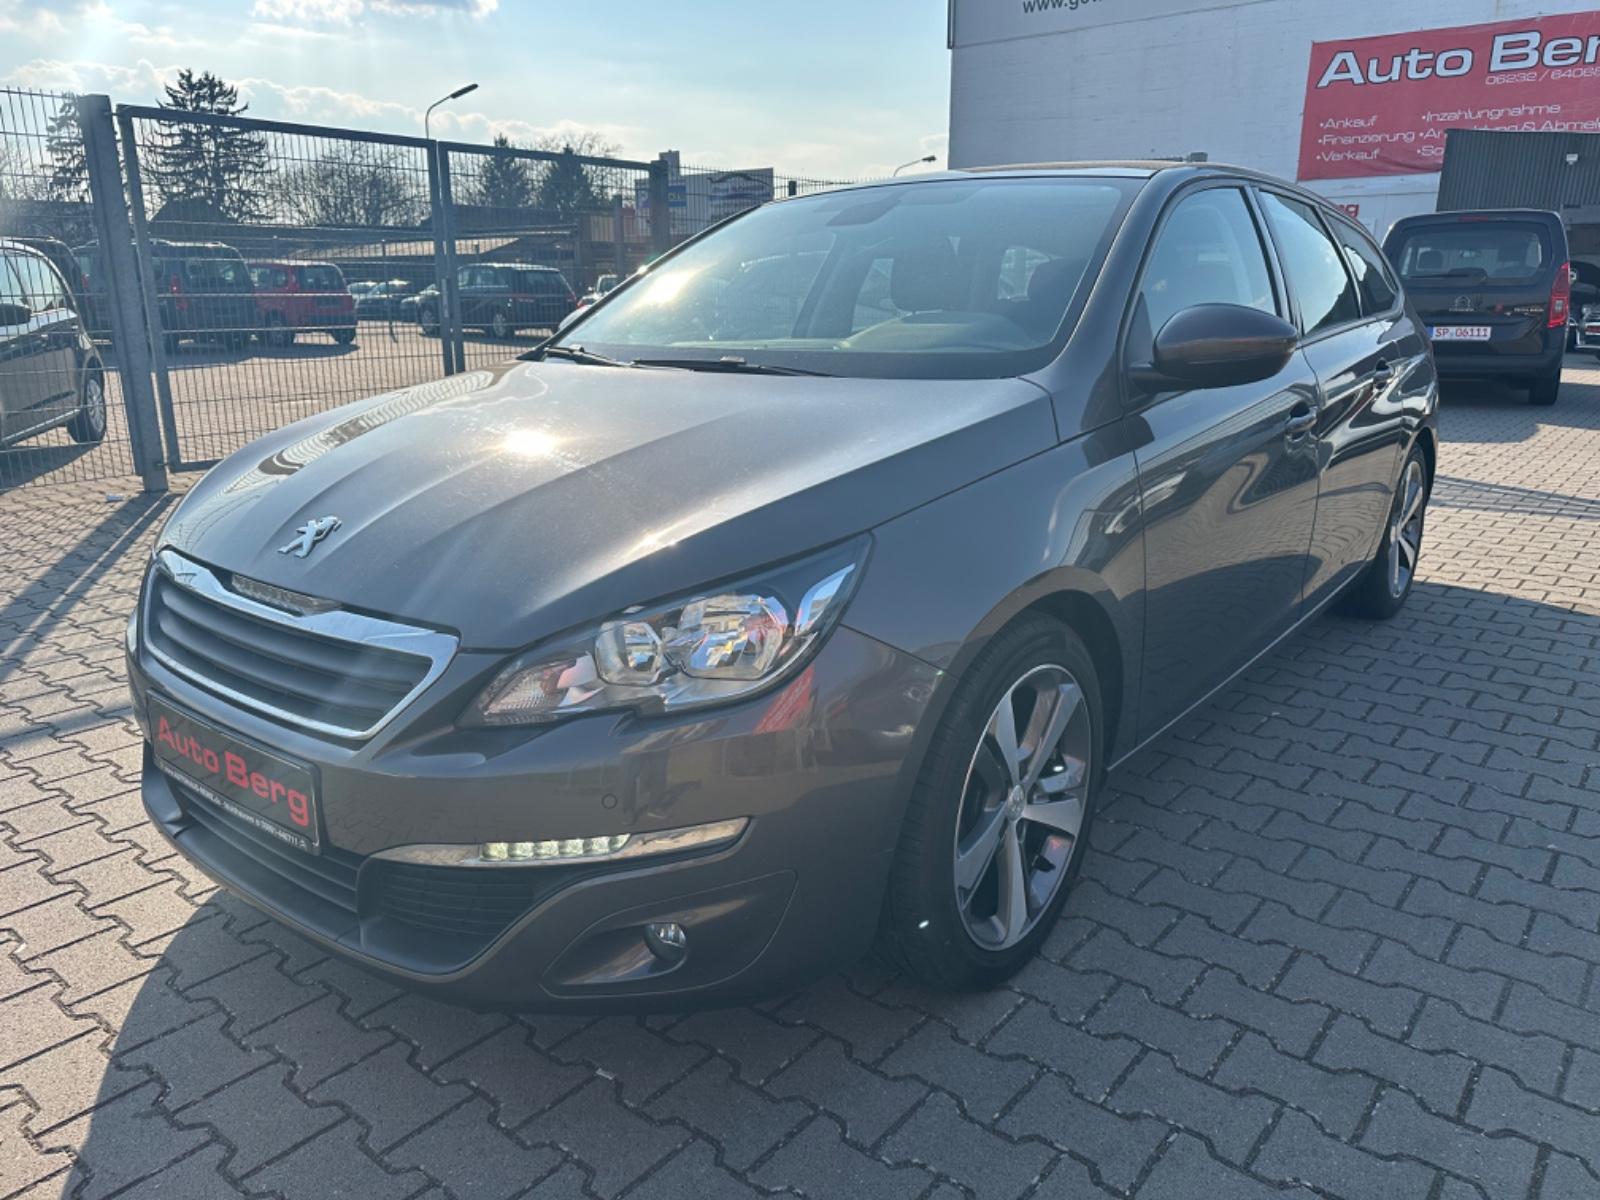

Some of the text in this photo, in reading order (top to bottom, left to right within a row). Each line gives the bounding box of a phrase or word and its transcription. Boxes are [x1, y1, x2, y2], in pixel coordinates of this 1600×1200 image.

[1316, 47, 1473, 89] Auto
[1426, 103, 1561, 122] Inzahlungnahme
[1323, 115, 1377, 129] Ankauf
[1323, 130, 1415, 145] Finanzierung
[1322, 148, 1380, 162] Verkauf
[158, 714, 220, 773] Auto
[224, 751, 310, 827] Berg
